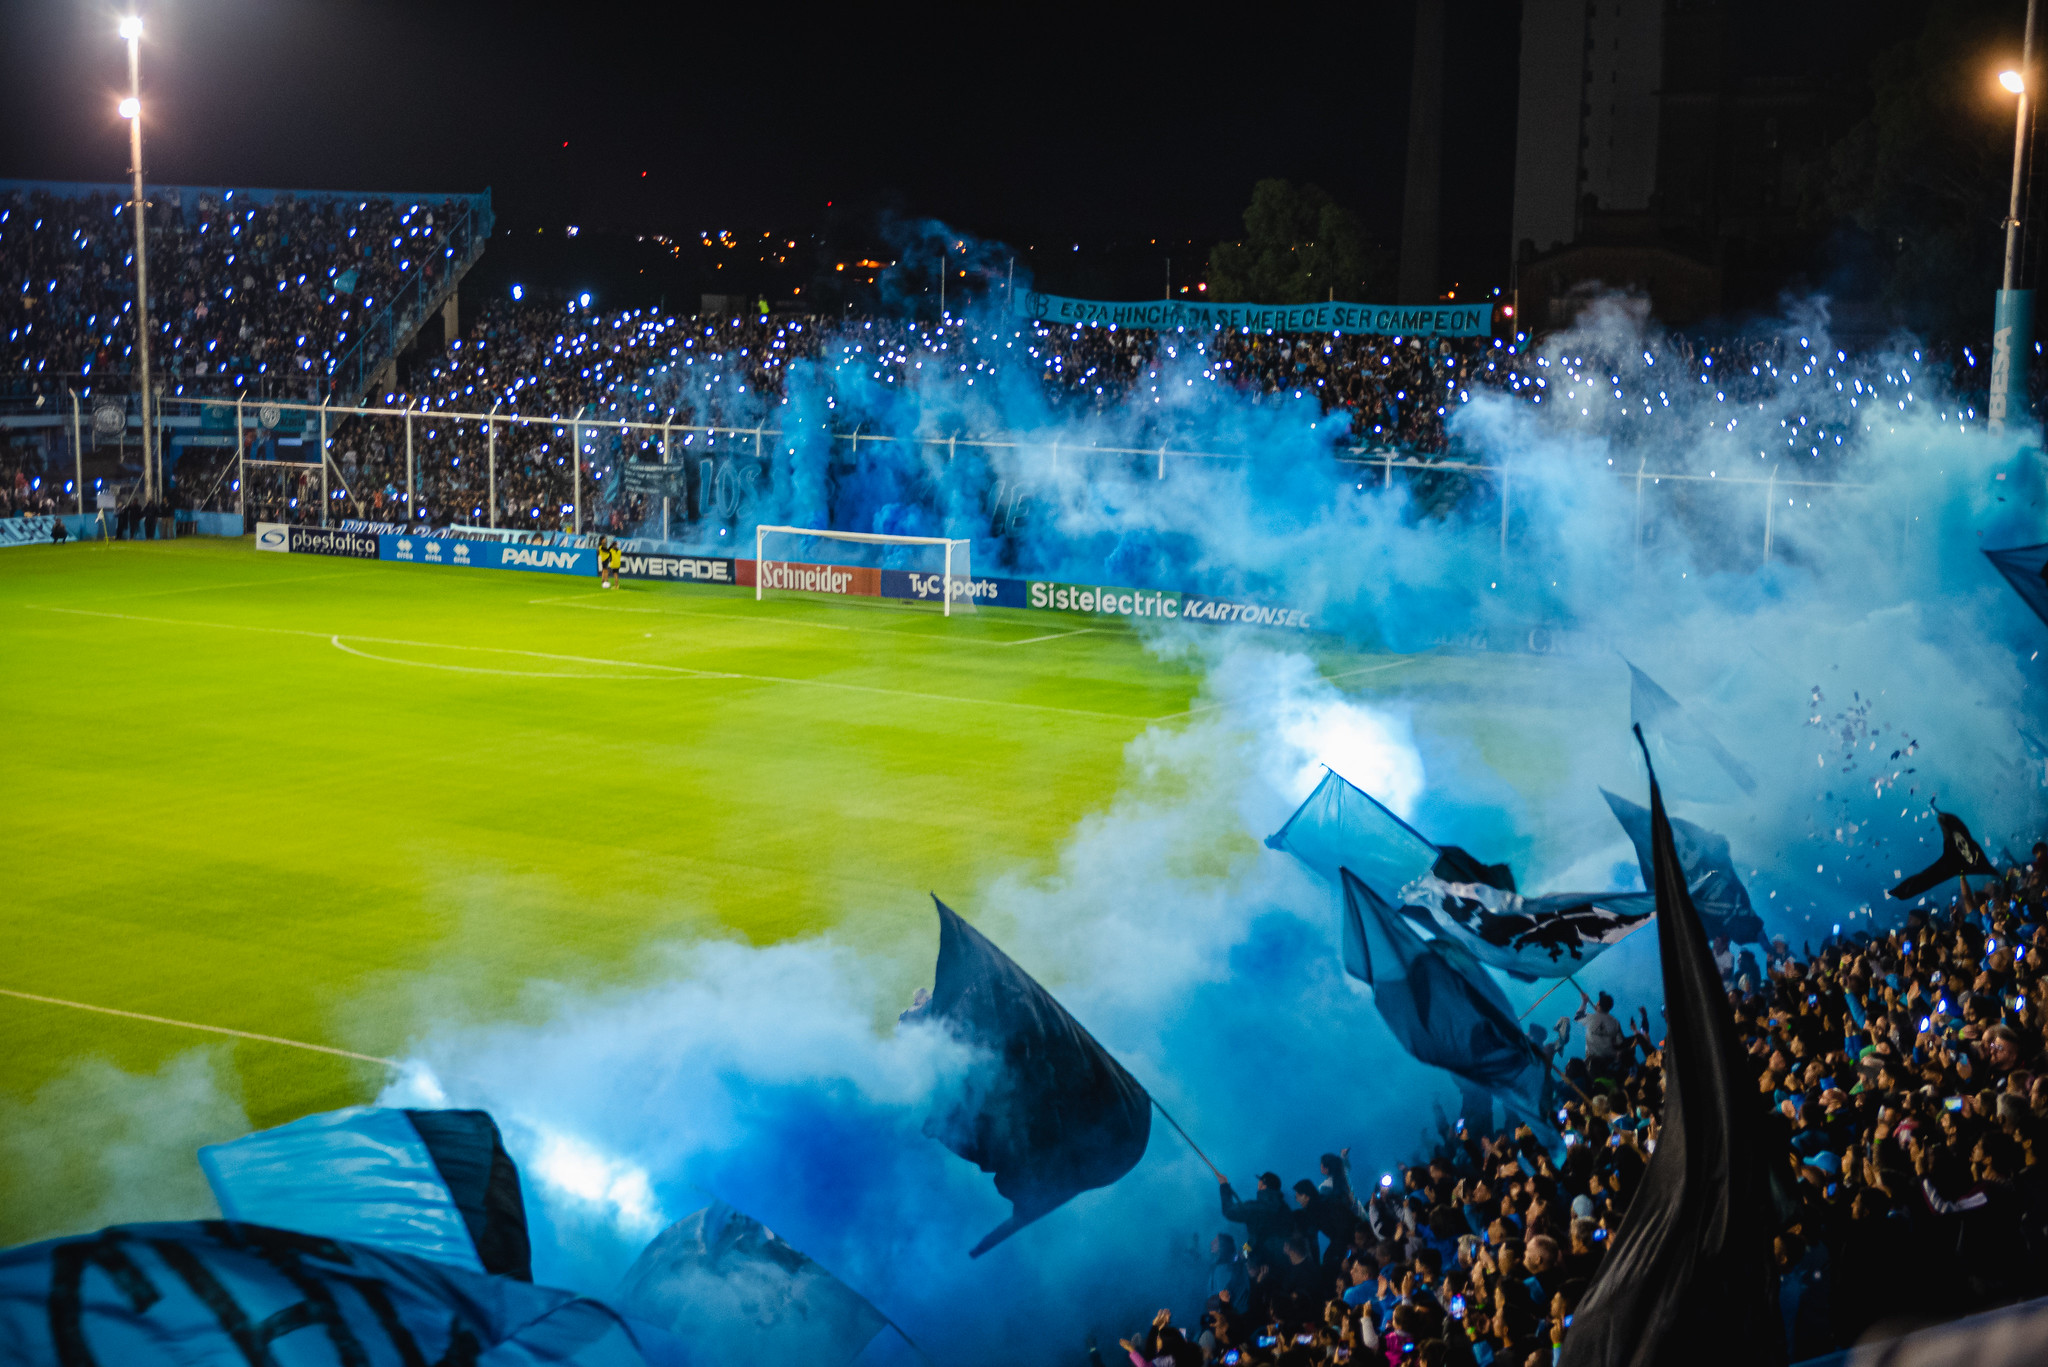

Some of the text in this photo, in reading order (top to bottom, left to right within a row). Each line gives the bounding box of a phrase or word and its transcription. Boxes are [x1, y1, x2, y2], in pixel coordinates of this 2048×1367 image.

[1216, 309, 1242, 328] SE
[1245, 307, 1330, 331] MERECE
[1332, 307, 1372, 328] SER
[1375, 309, 1481, 331] CAMPEON
[292, 529, 376, 553] pbestatica
[501, 548, 581, 569] PAUNY
[598, 555, 729, 581] OWERADE
[762, 560, 853, 594] Schneider
[908, 573, 940, 598] TyC
[1030, 582, 1178, 618] Sistelectric
